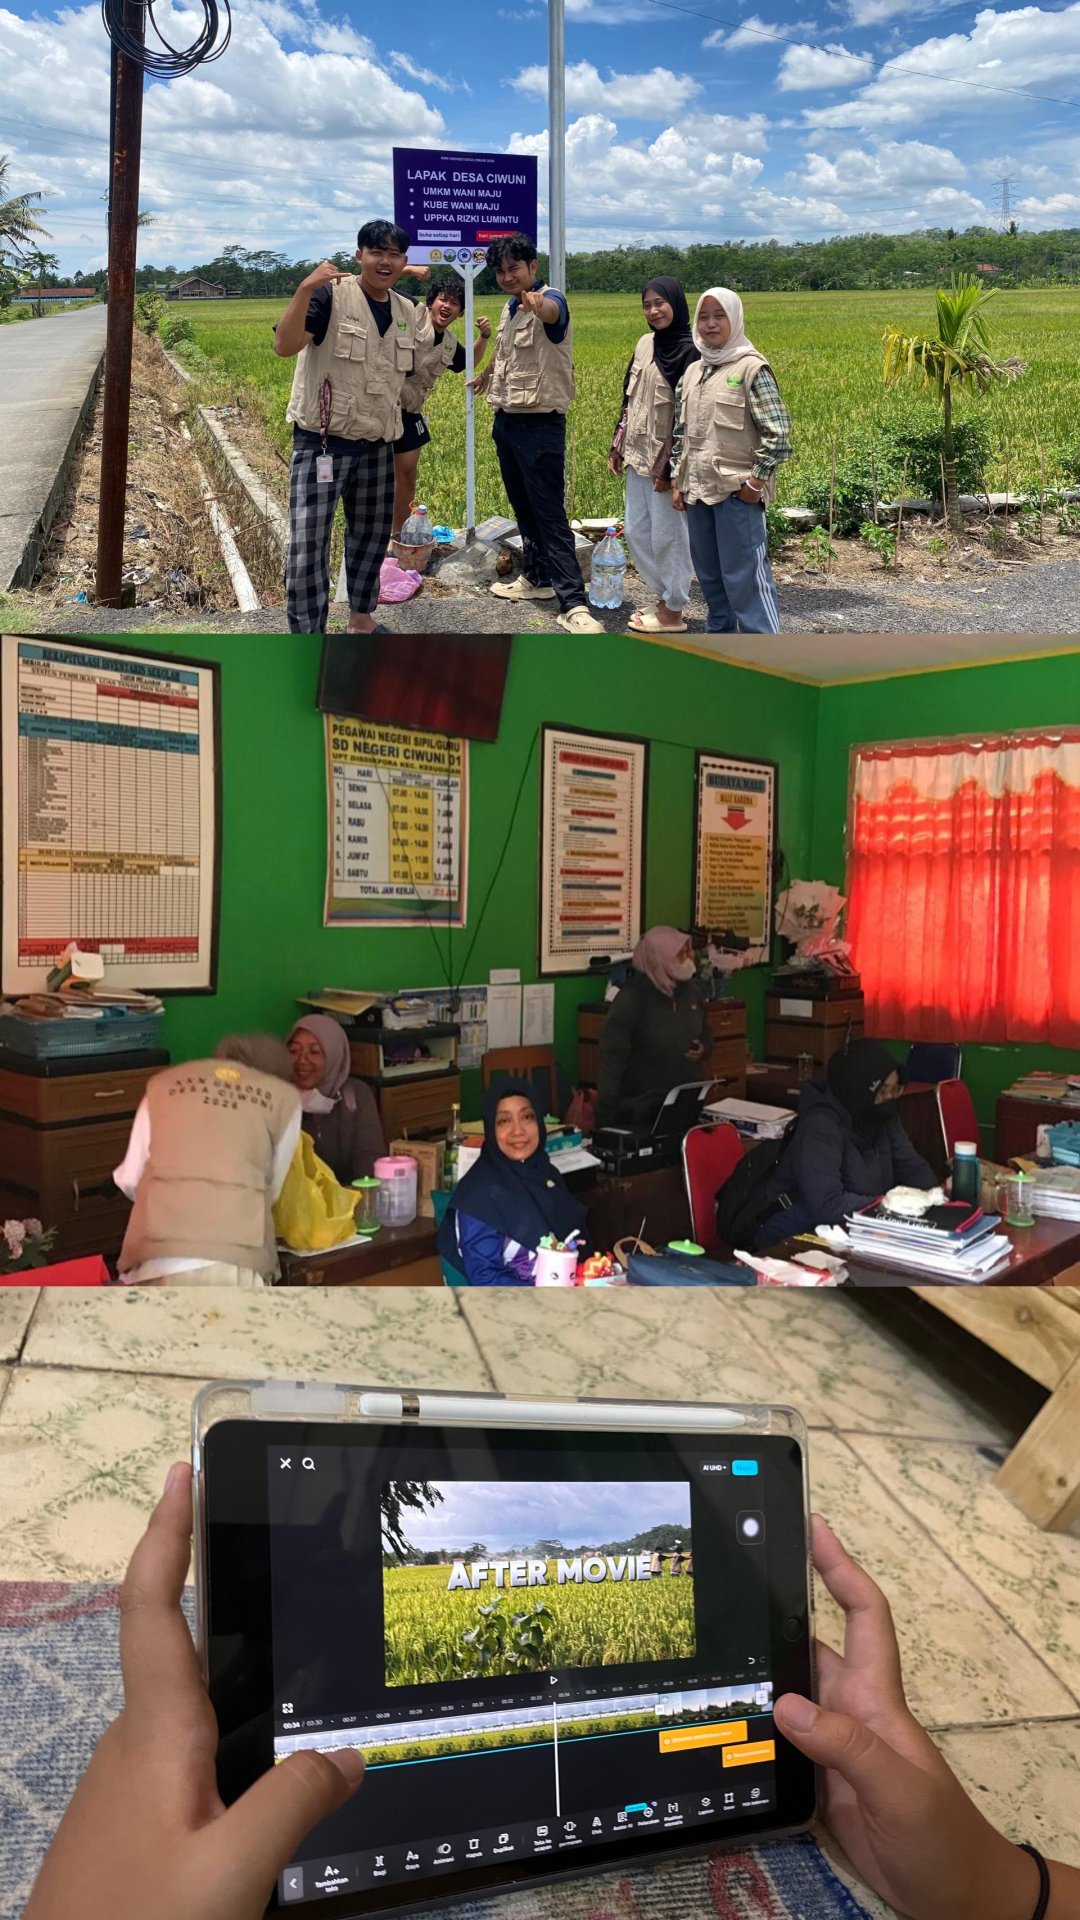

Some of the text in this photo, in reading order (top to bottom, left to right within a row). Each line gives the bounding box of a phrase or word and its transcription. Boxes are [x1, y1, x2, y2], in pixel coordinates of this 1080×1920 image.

[407, 170, 526, 185] LAPAK DESA CIWUNI
[423, 187, 502, 198] UMKM WANI MAJU
[423, 201, 500, 210] KUBE WANI MAJU
[424, 214, 518, 224] UPPKA RIZKI LUMINTU
[333, 724, 376, 740] PEGAWAI
[378, 731, 411, 745] NEGERI
[332, 738, 349, 750] SD
[353, 741, 399, 758] NEGERI
[403, 748, 445, 764] CIWUNI
[357, 769, 373, 777] HARI
[348, 783, 367, 792] SENIN
[348, 801, 372, 810] SELASA
[348, 817, 365, 827] RABU
[348, 835, 368, 844] KAMIS
[347, 869, 368, 878] SABTU
[360, 886, 379, 894] TOTAL
[381, 886, 394, 894] JAM
[396, 886, 415, 894] KERJA
[169, 1085, 273, 1112] DESA CIWUNI
[447, 1556, 652, 1591] AFTER MOVIE
[283, 1722, 300, 1730] 00:34
